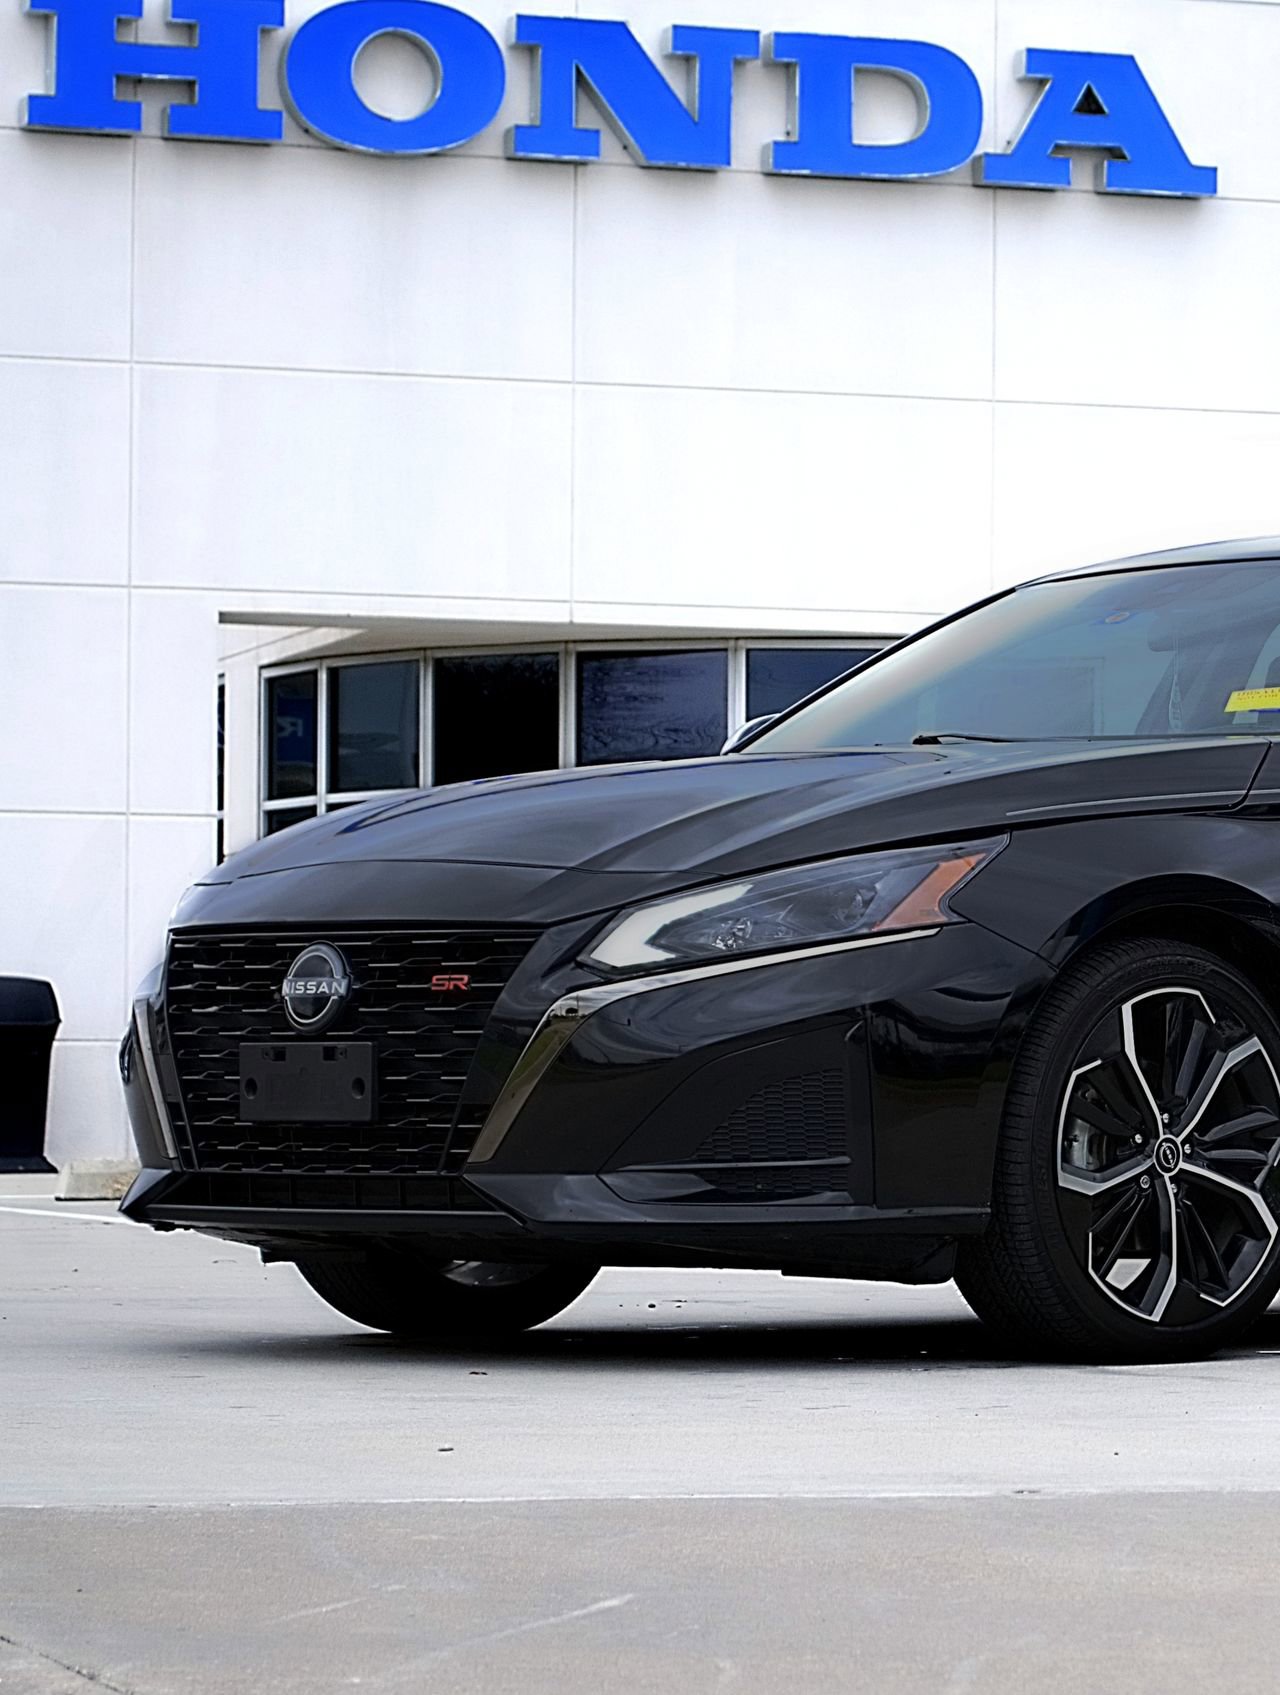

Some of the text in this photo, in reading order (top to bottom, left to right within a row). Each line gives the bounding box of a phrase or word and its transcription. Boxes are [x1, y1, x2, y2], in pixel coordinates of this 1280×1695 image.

[22, 0, 1218, 197] HONDA
[282, 981, 345, 995] NISSAN
[432, 975, 469, 990] SR
